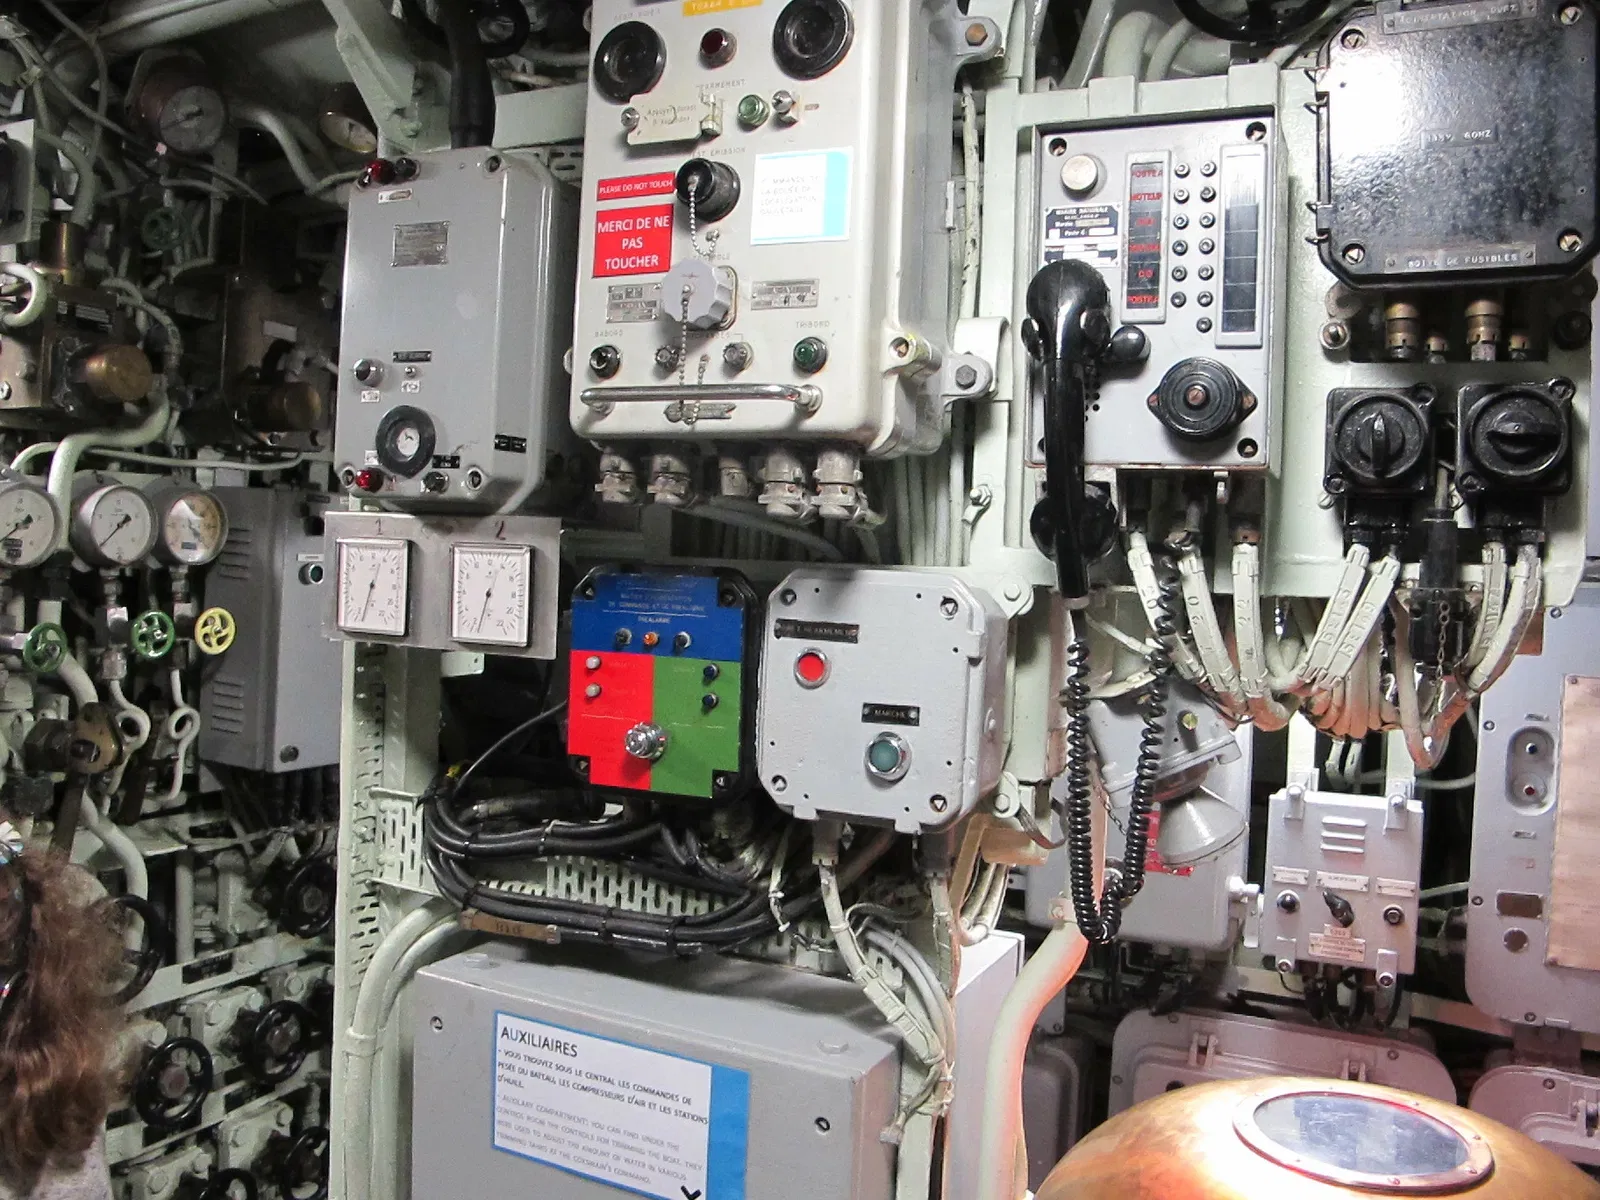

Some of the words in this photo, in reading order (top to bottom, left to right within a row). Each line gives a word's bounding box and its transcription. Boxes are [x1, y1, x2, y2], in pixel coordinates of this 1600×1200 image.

[600, 184, 621, 194] PLEASE
[622, 184, 632, 192] DO
[634, 182, 648, 190] NOT
[650, 180, 673, 189] TOUCH
[598, 220, 633, 233] MERCI
[636, 217, 651, 229] DE
[654, 216, 670, 227] NE
[622, 237, 643, 250] PAS
[605, 255, 658, 270] TOUCHER
[1464, 253, 1518, 264] FUSIBLES
[375, 518, 383, 536] 1
[494, 520, 506, 540] 2
[501, 1026, 578, 1058] AUXILIAIRES
[504, 1049, 522, 1060] VOUS
[523, 1054, 553, 1069] TROUVEZ
[555, 1063, 572, 1075] SOUS
[575, 1069, 582, 1077] LE
[585, 1072, 615, 1086] CENTRAL
[618, 1080, 630, 1090] LES
[632, 1083, 680, 1102] COMMANDES
[682, 1096, 692, 1106] DE
[558, 1079, 570, 1088] LES
[572, 1082, 624, 1102] COMPRESSEURS
[660, 1105, 671, 1114] LES
[674, 1109, 708, 1125] STATIONS
[592, 1122, 604, 1130] YOU
[607, 1125, 620, 1134] CAN
[623, 1130, 639, 1139] FIND
[642, 1135, 665, 1147] UNDER
[666, 1142, 680, 1152] THE
[514, 1125, 530, 1134] USED
[623, 1157, 646, 1168] WATER
[657, 1166, 687, 1181] VARIOUS
[559, 1151, 570, 1159] THE
[561, 1126, 594, 1141] CONTROLS
[648, 1150, 660, 1160] THE
[685, 1161, 703, 1171] THEY
